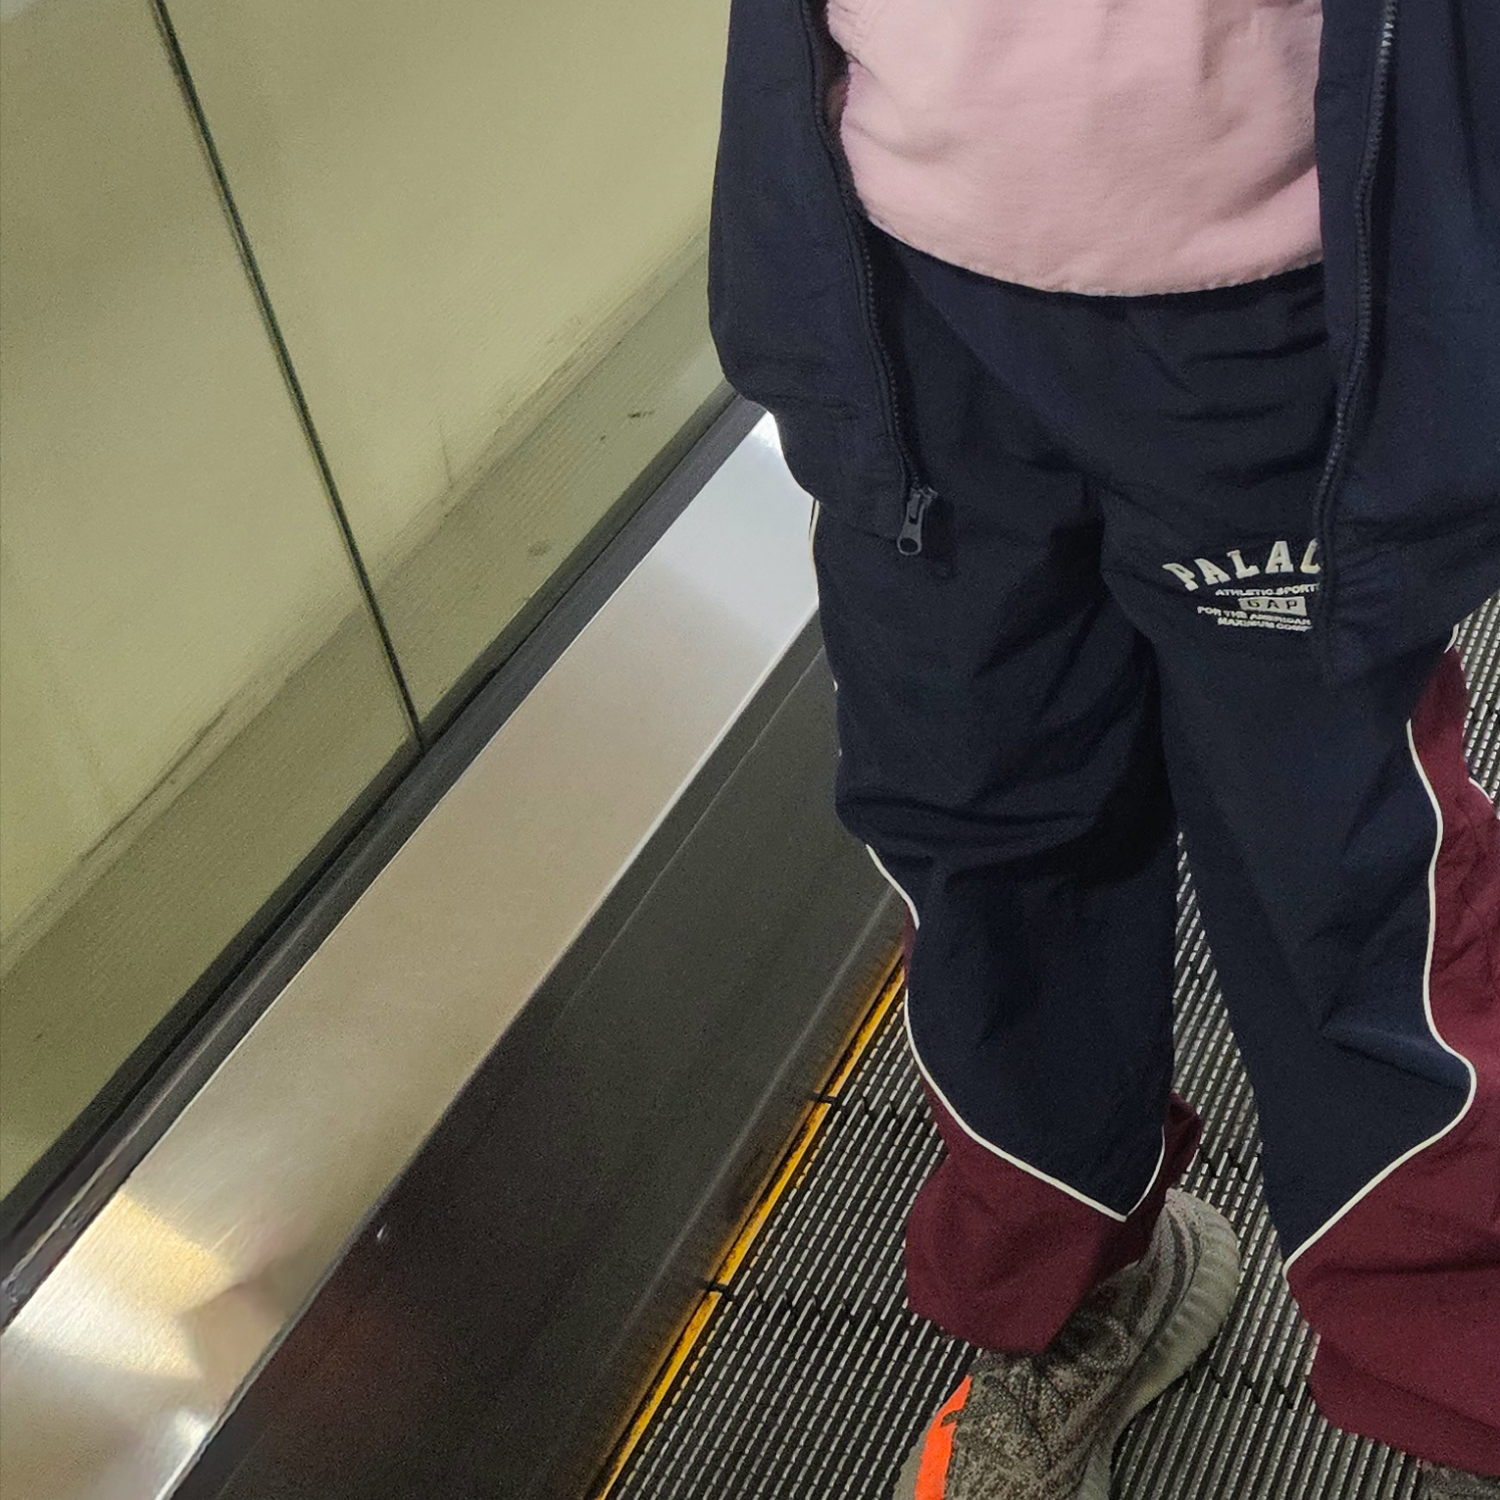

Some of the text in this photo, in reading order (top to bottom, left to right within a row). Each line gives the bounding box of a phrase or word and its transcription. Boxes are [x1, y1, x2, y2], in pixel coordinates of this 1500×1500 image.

[1162, 538, 1321, 591] PALAC
[1215, 588, 1274, 596] ATHLETIC
[1247, 599, 1298, 610] GAP
[1197, 606, 1311, 625] FOR THE AMERICAN
[1217, 617, 1275, 629] MAXIMUM
